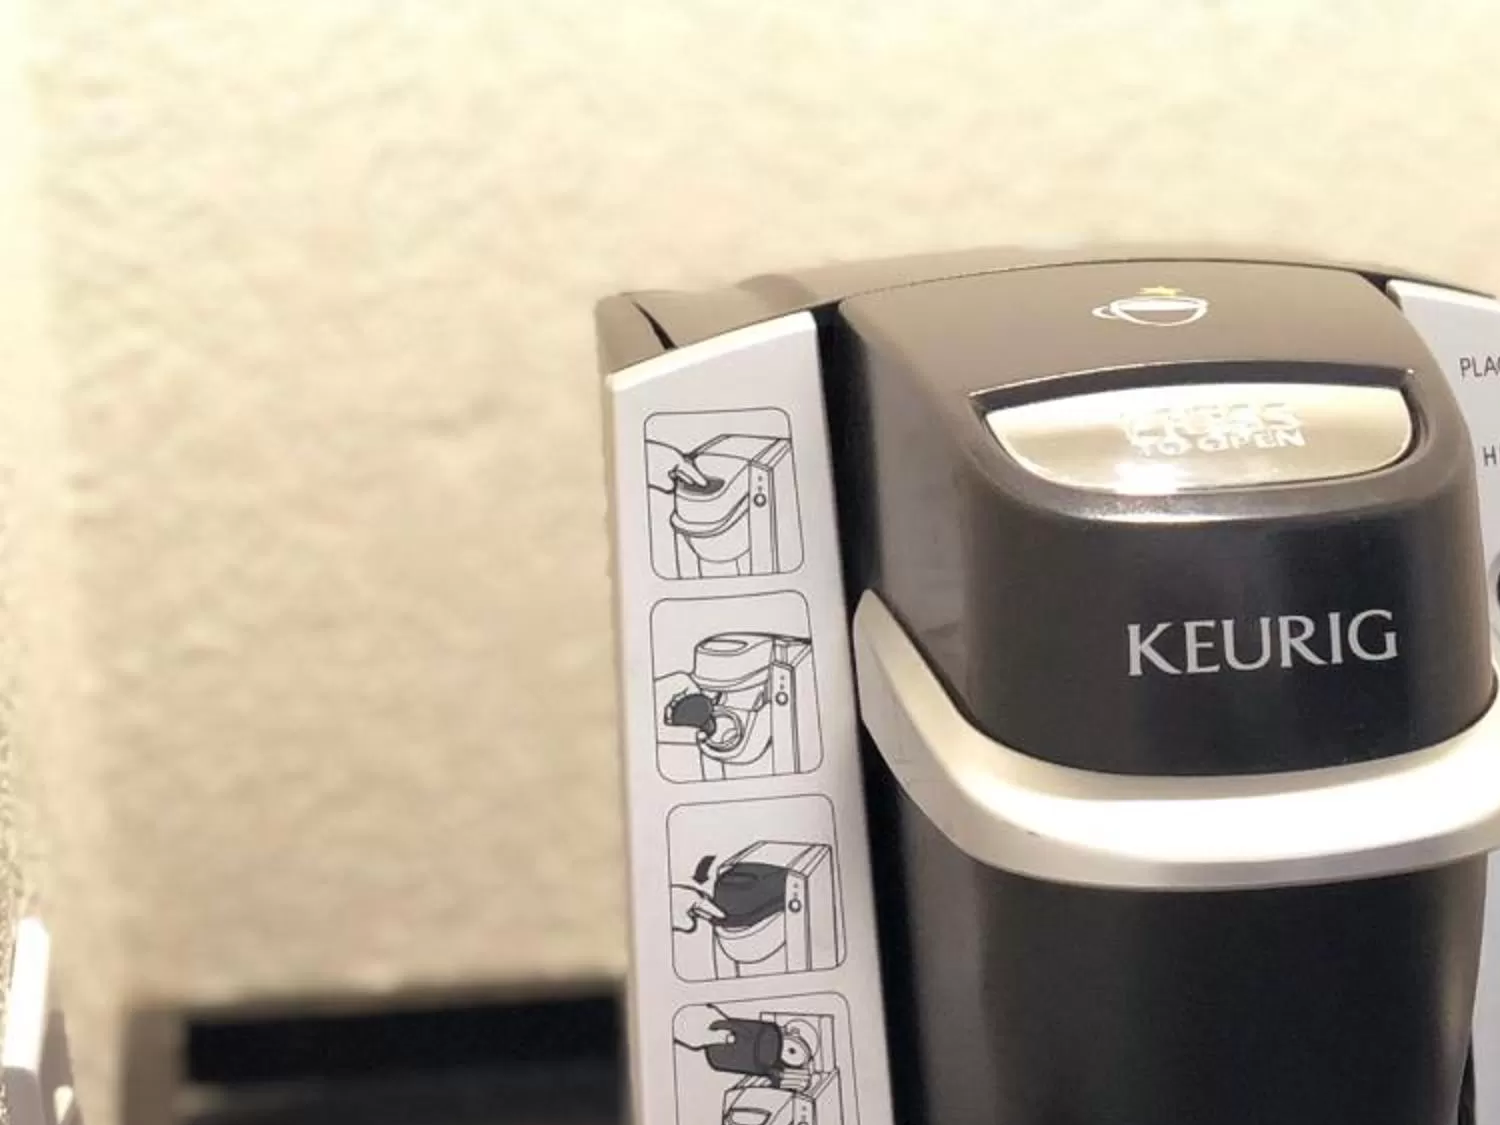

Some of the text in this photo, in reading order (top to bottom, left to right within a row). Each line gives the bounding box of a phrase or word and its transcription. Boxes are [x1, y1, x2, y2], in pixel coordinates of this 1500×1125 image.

[1132, 427, 1306, 456] TO OPEN
[1127, 608, 1400, 676] KEURIG
